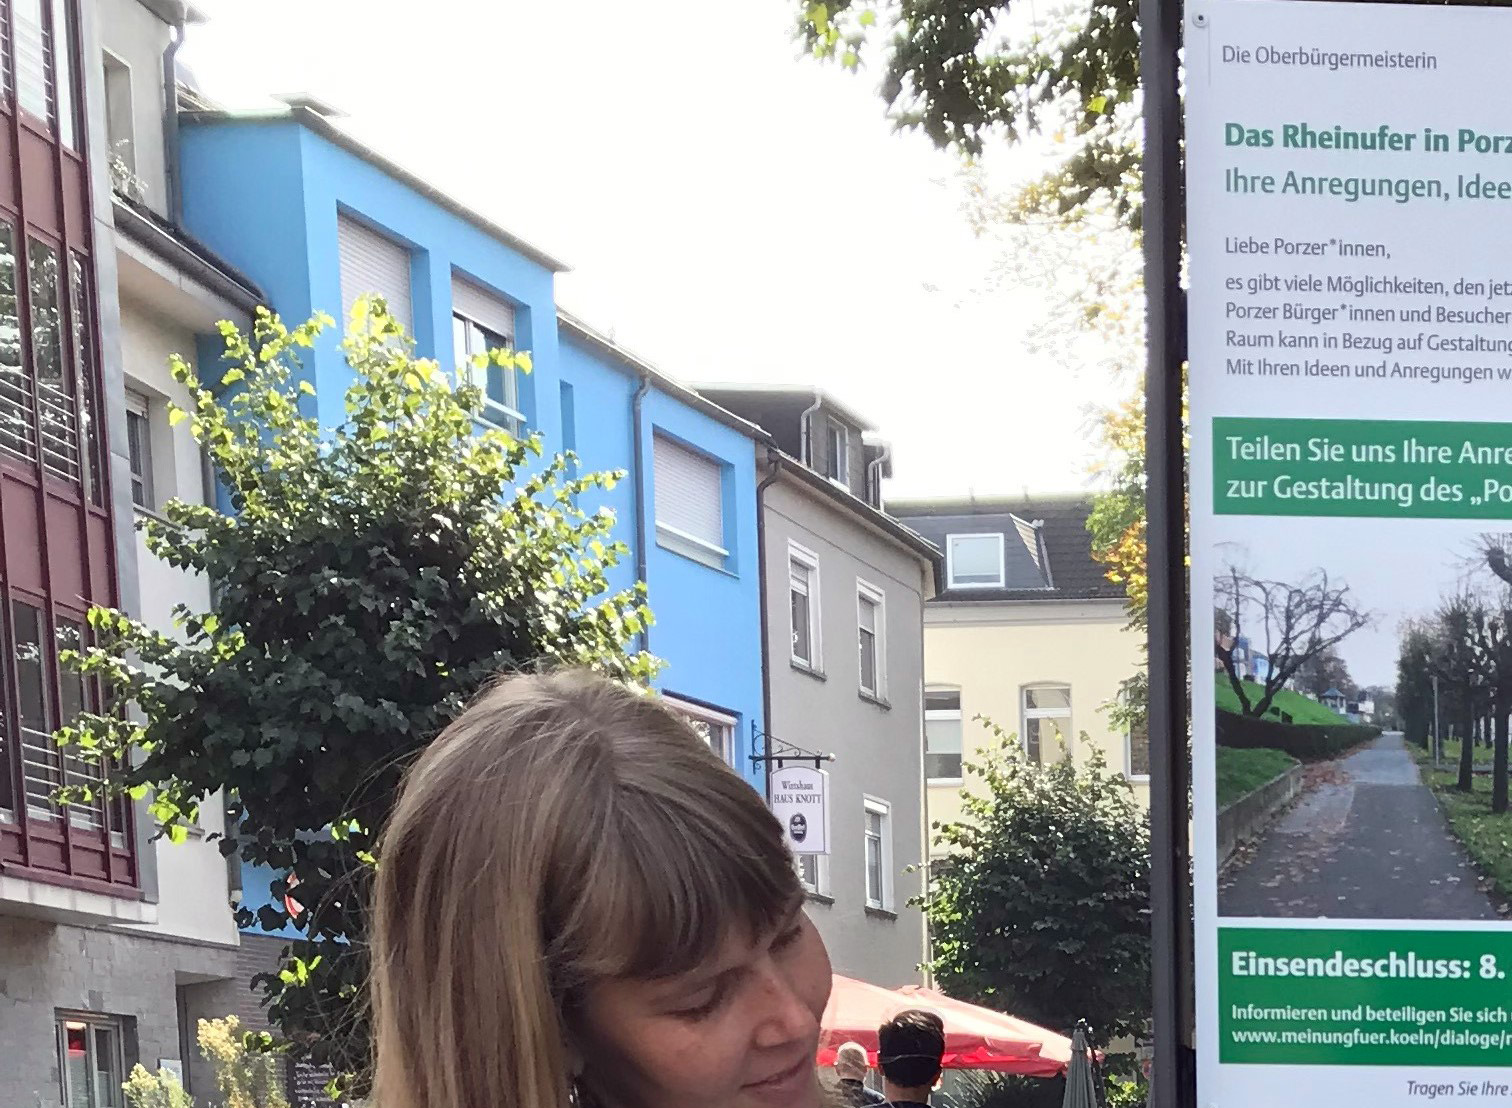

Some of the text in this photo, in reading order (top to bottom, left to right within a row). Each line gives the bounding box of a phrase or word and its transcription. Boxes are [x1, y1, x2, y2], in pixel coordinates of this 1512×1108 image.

[1222, 44, 1437, 72] Die Oberbürgermeisterin
[1225, 122, 1274, 148] Das
[1282, 122, 1417, 152] Rheinufer
[1423, 127, 1450, 153] in
[1225, 166, 1276, 194] Ihre
[1281, 169, 1450, 205] Anregungen,
[1225, 236, 1270, 255] Liebe
[1225, 277, 1244, 290] es
[1247, 272, 1281, 296] gibt
[1284, 273, 1323, 293] viele
[1327, 274, 1449, 298] Möglichkeiten,
[1453, 277, 1485, 296] den
[1225, 301, 1280, 320] Porzer
[1399, 304, 1432, 324] und
[1226, 329, 1274, 348] Raum
[1278, 329, 1319, 349] kann
[1323, 332, 1338, 350] in
[1342, 332, 1393, 355] Bezug
[1396, 332, 1425, 351] auf
[1226, 358, 1254, 376] Mit
[1257, 358, 1300, 376] Ihren
[1304, 358, 1351, 378] Ideen
[1354, 360, 1387, 379] und
[1390, 361, 1494, 385] Anregungen
[1225, 435, 1301, 462] Teilen
[1307, 437, 1345, 462] Sie
[1351, 444, 1396, 463] uns
[1403, 437, 1453, 464] Ihre
[1226, 479, 1268, 499] zur
[1273, 474, 1413, 508] Gestaltung
[1419, 475, 1464, 502] des
[773, 793, 822, 804] HAUS KNOTT
[1232, 950, 1471, 979] Einsendeschluss:
[1479, 954, 1506, 980] 8.
[1231, 1003, 1328, 1021] Informieren
[1331, 1004, 1363, 1022] und
[1365, 1005, 1447, 1025] beteiligen
[1449, 1006, 1474, 1023] Sie
[1476, 1006, 1508, 1023] sich
[1407, 1080, 1455, 1100] Tragen
[1457, 1080, 1479, 1096] Sie
[1481, 1080, 1509, 1097] Ihre
